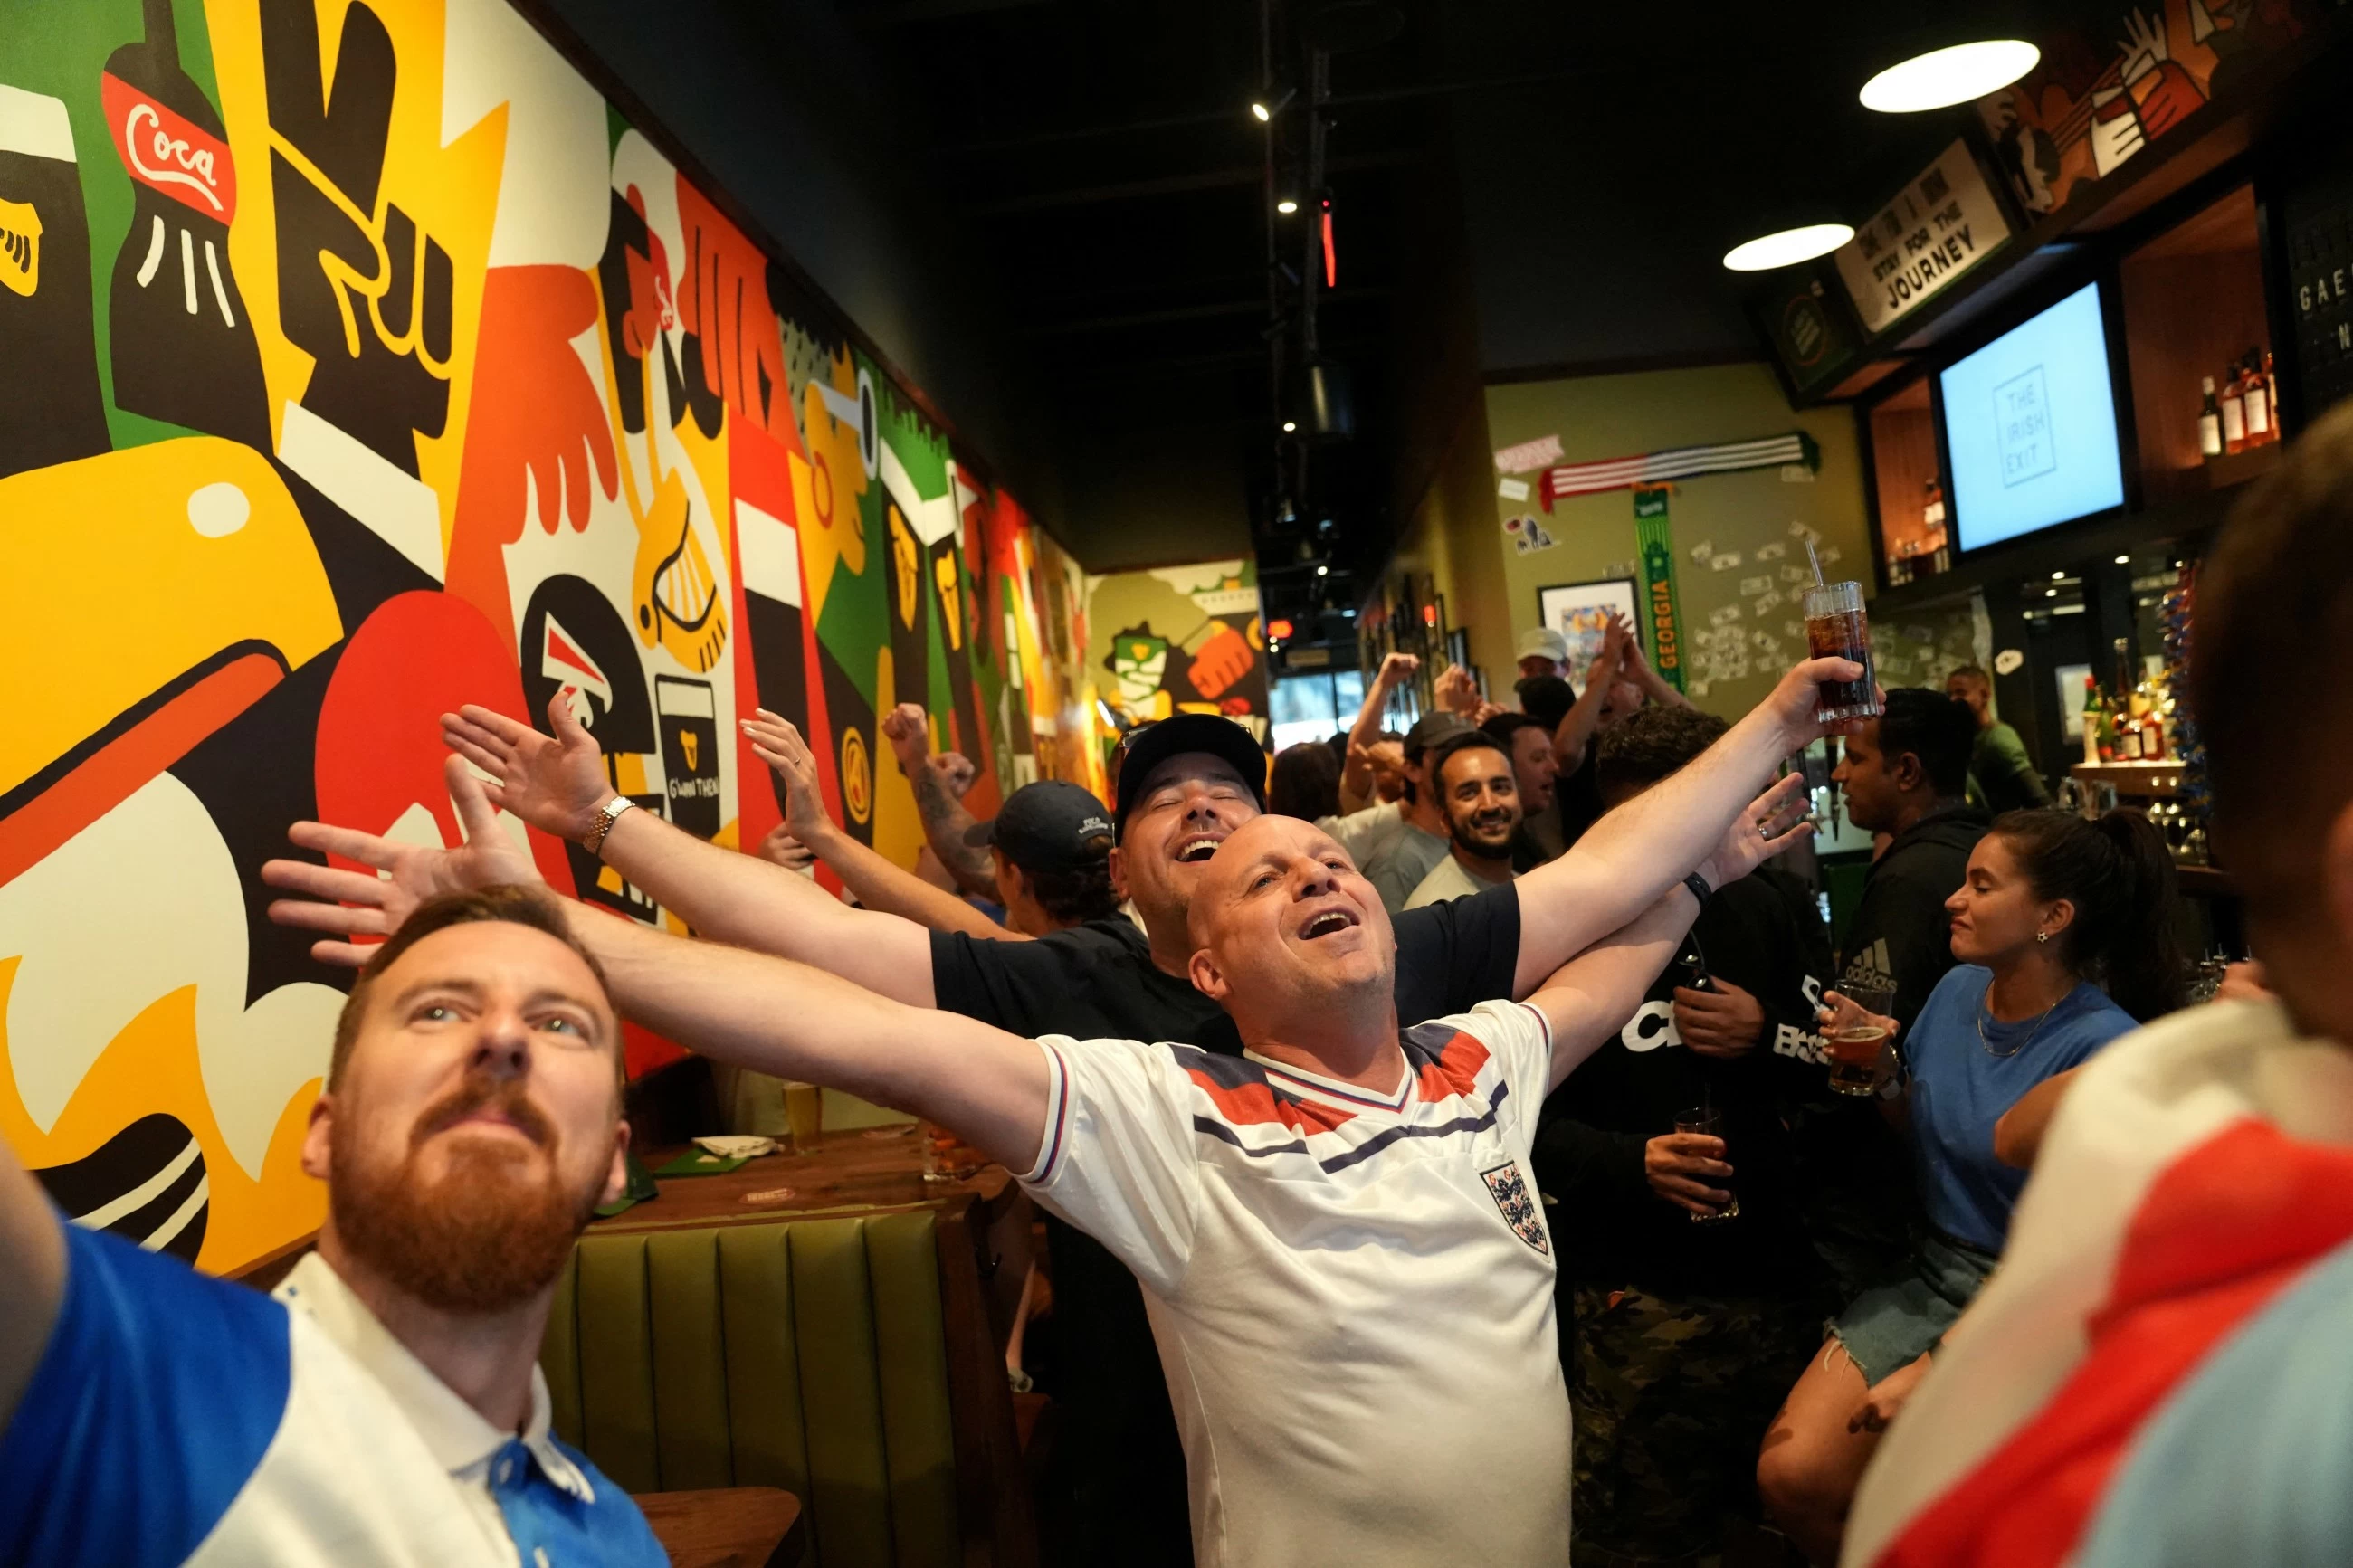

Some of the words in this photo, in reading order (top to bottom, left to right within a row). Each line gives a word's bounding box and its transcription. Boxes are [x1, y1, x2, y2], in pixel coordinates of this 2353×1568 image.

[126, 103, 224, 211] Coca
[1872, 251, 1901, 282] STAY
[1904, 227, 1932, 257] FOR
[1933, 200, 1963, 232] THE
[1887, 223, 1975, 309] JOURNEY
[2300, 263, 2353, 311] GAE
[2006, 383, 2035, 413] THE
[2006, 410, 2045, 443] IRISH
[2005, 443, 2037, 475] EXIT
[1652, 579, 1679, 670] GEORGIA
[1845, 965, 1898, 994] adidas
